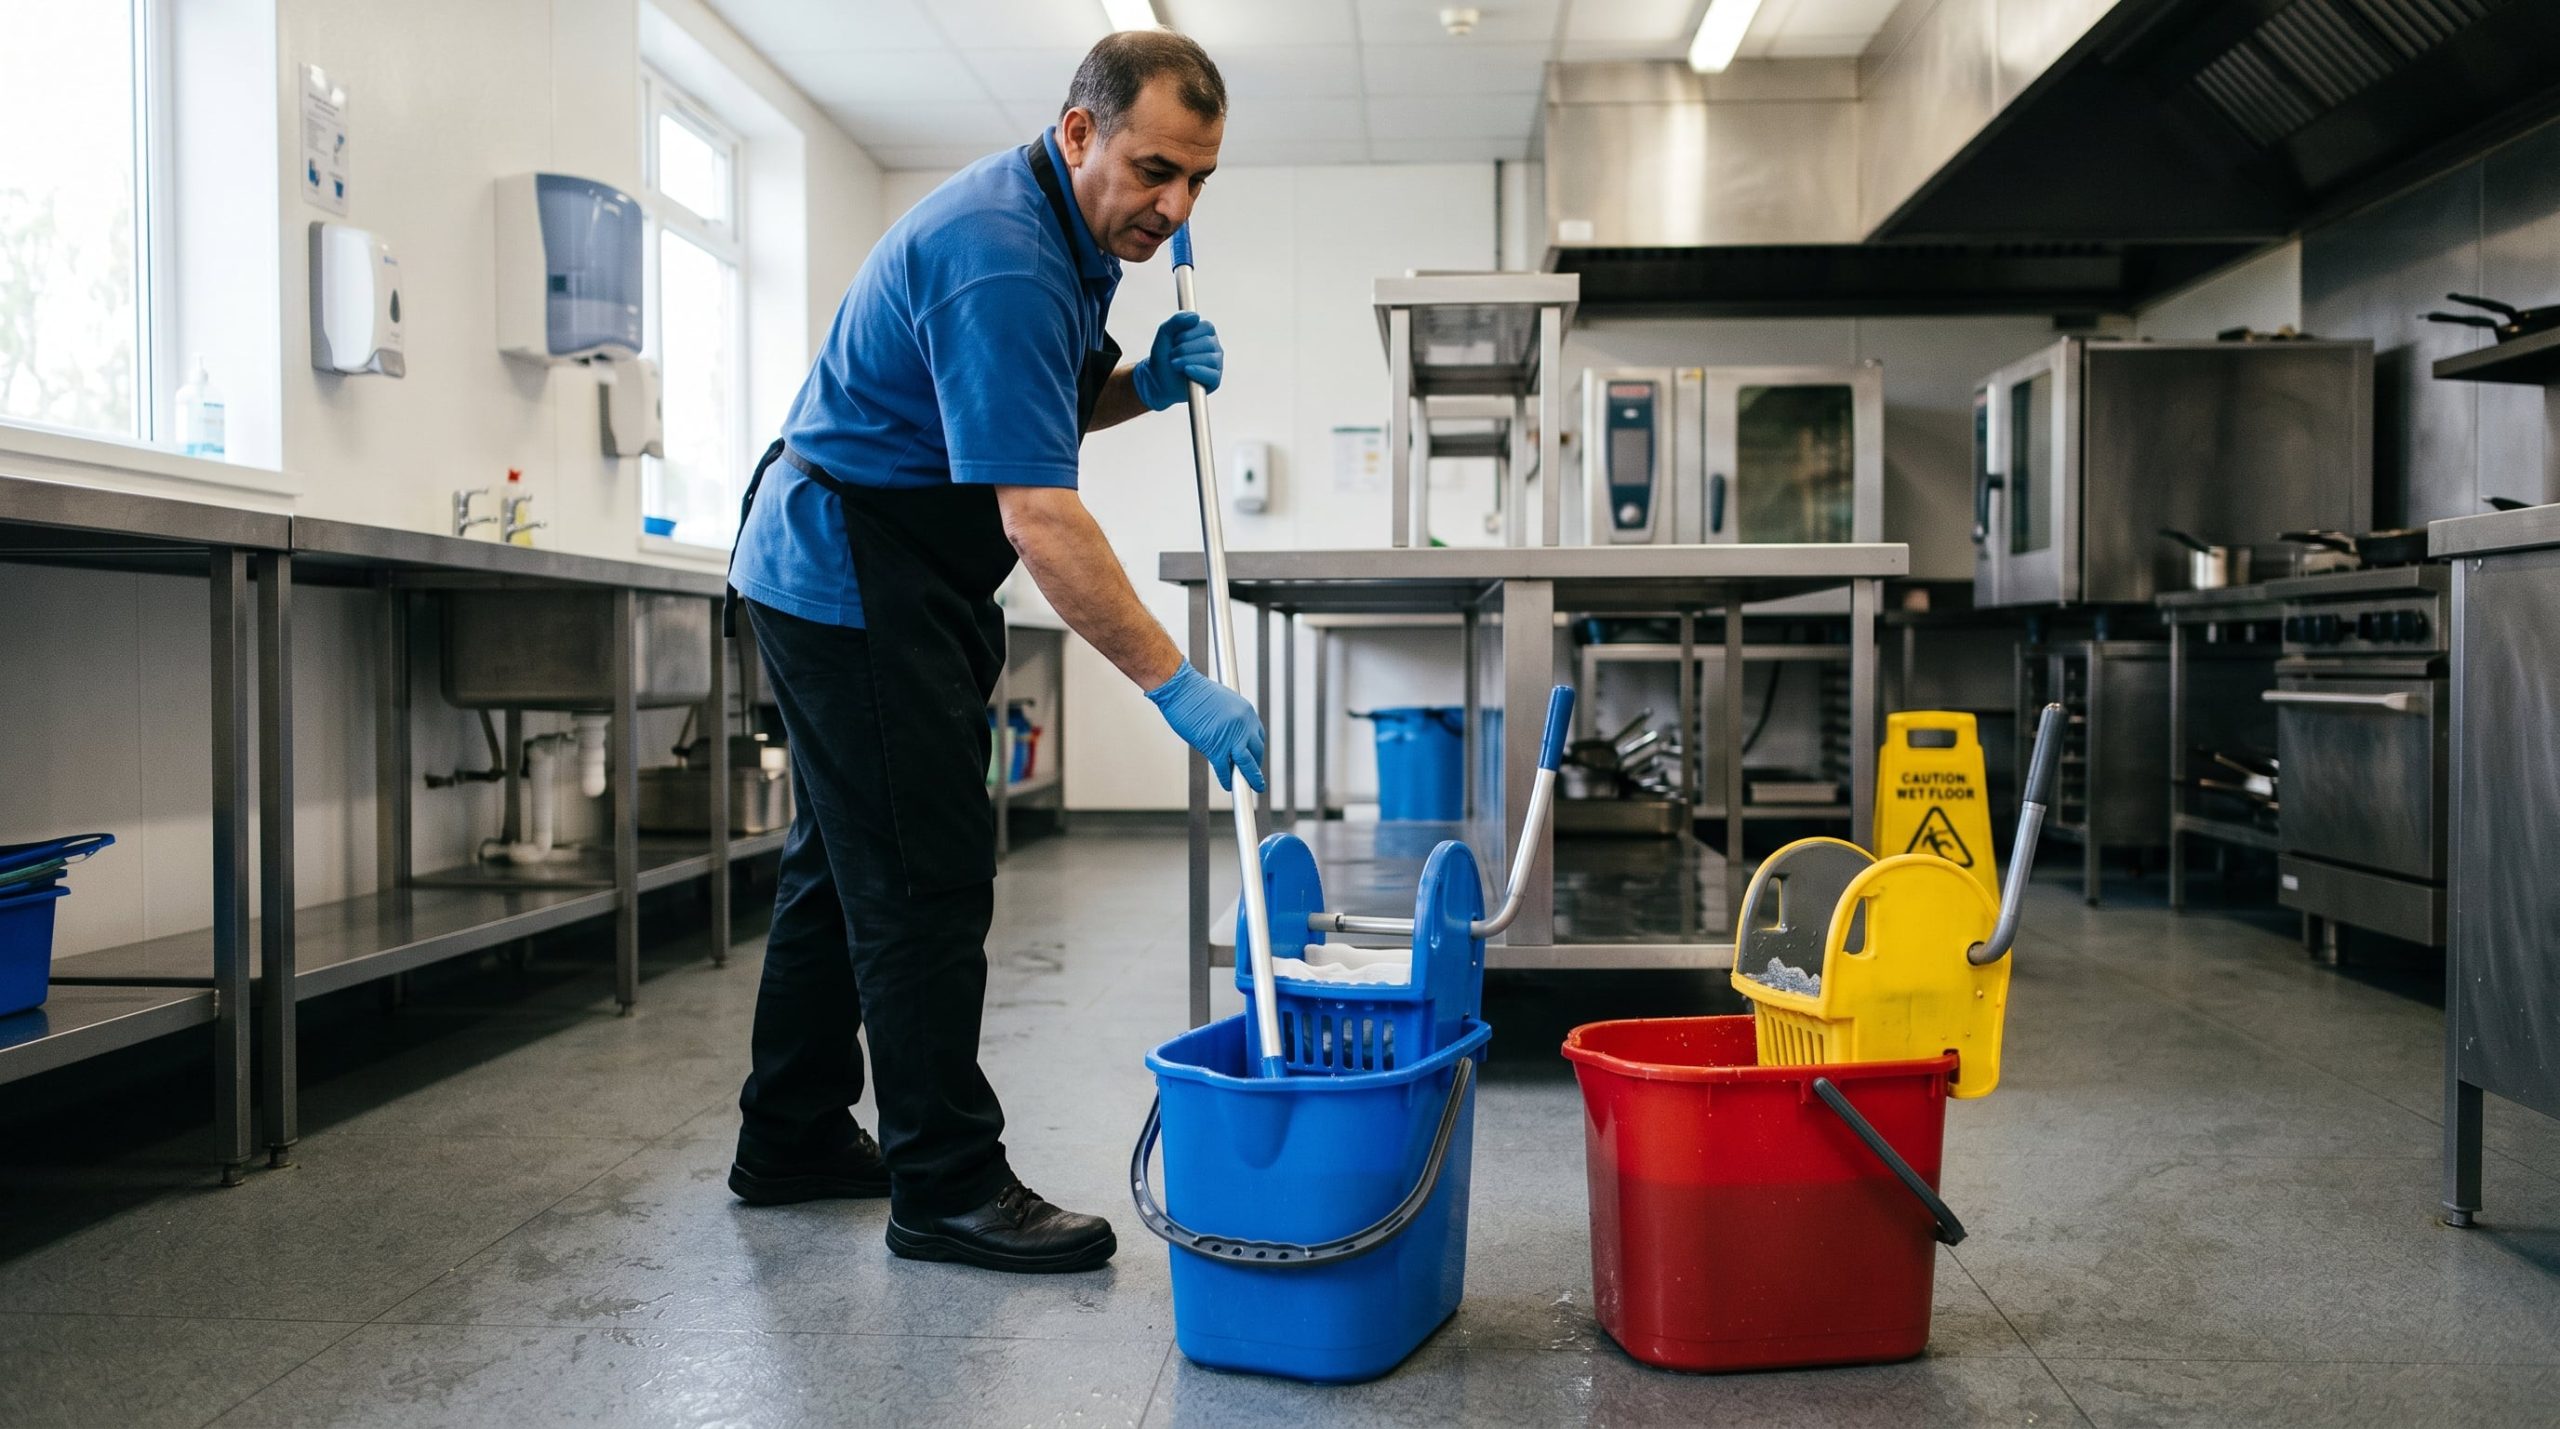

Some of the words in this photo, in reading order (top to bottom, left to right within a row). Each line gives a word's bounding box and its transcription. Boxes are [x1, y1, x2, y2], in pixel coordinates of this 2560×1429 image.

[1901, 772, 1965, 784] CAUTION
[1897, 788, 1924, 800] WET
[1929, 787, 1975, 800] FLOOR
